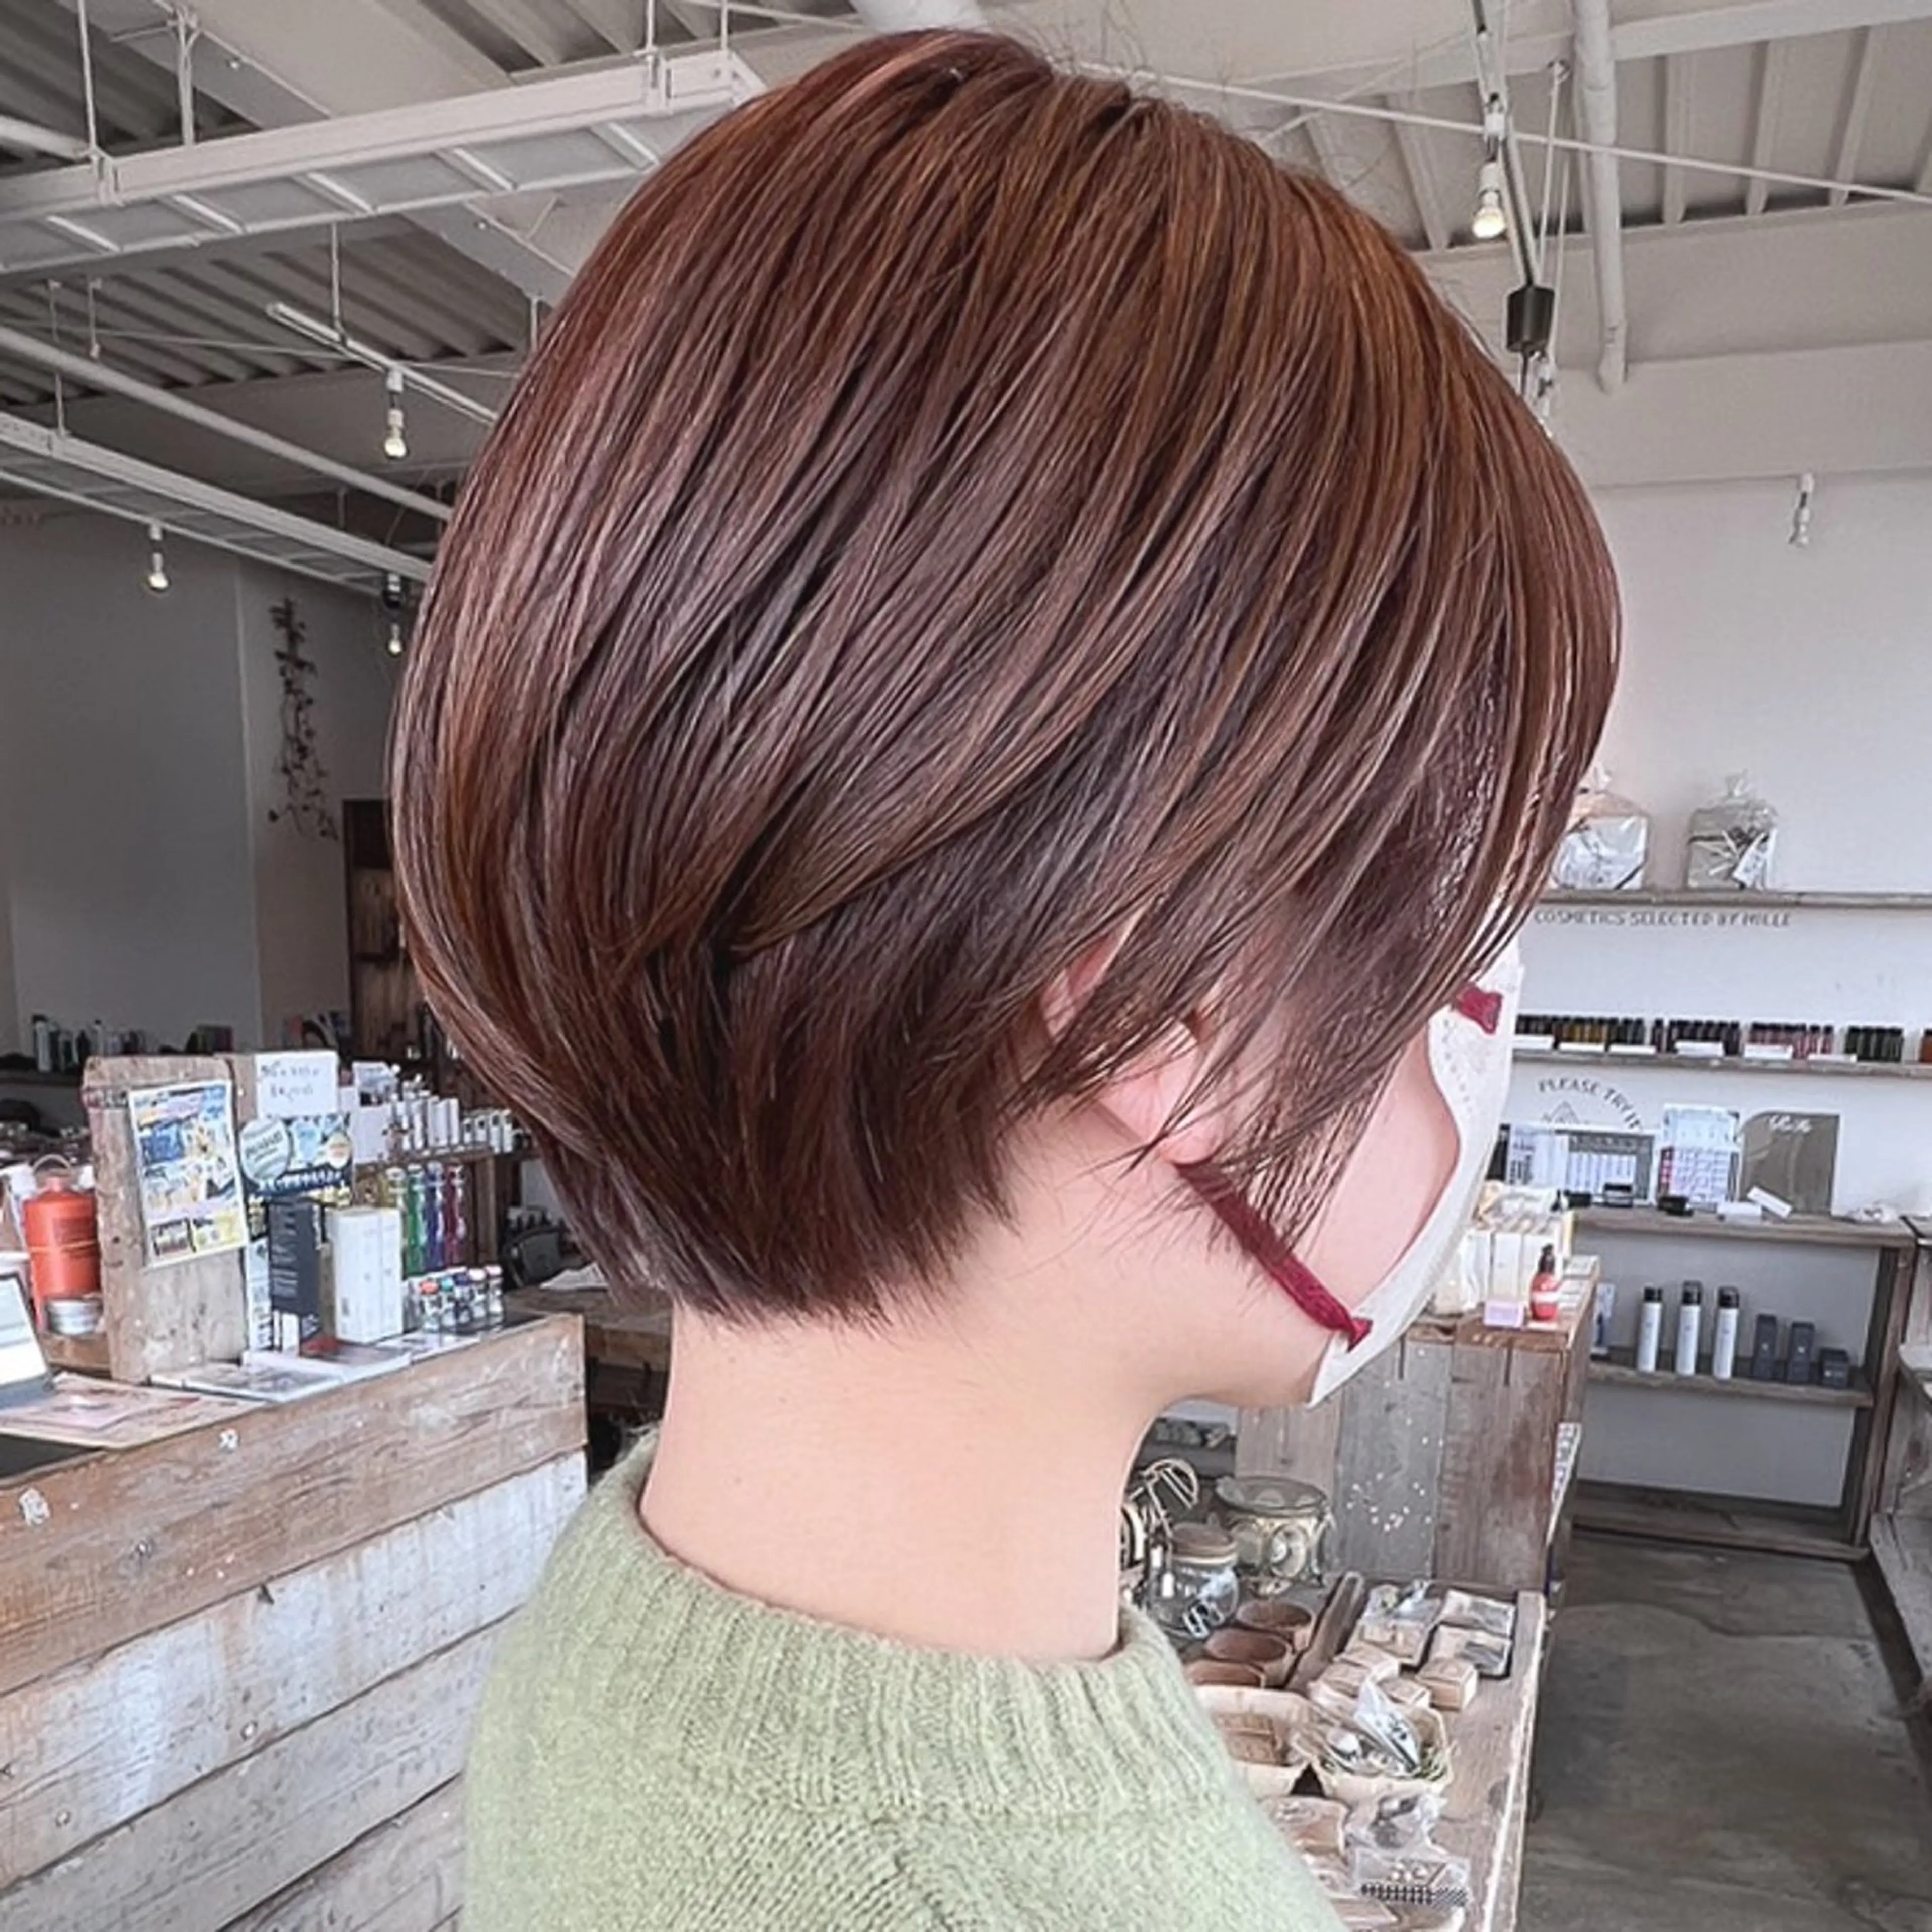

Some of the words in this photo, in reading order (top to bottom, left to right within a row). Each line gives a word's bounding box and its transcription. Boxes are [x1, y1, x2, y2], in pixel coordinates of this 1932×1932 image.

[1534, 910, 1626, 926] COSMETICS
[1629, 910, 1711, 927] SELECTED
[1716, 911, 1739, 927] BY
[1539, 1077, 1600, 1096] PLEASE
[1603, 1087, 1633, 1113] TRY
